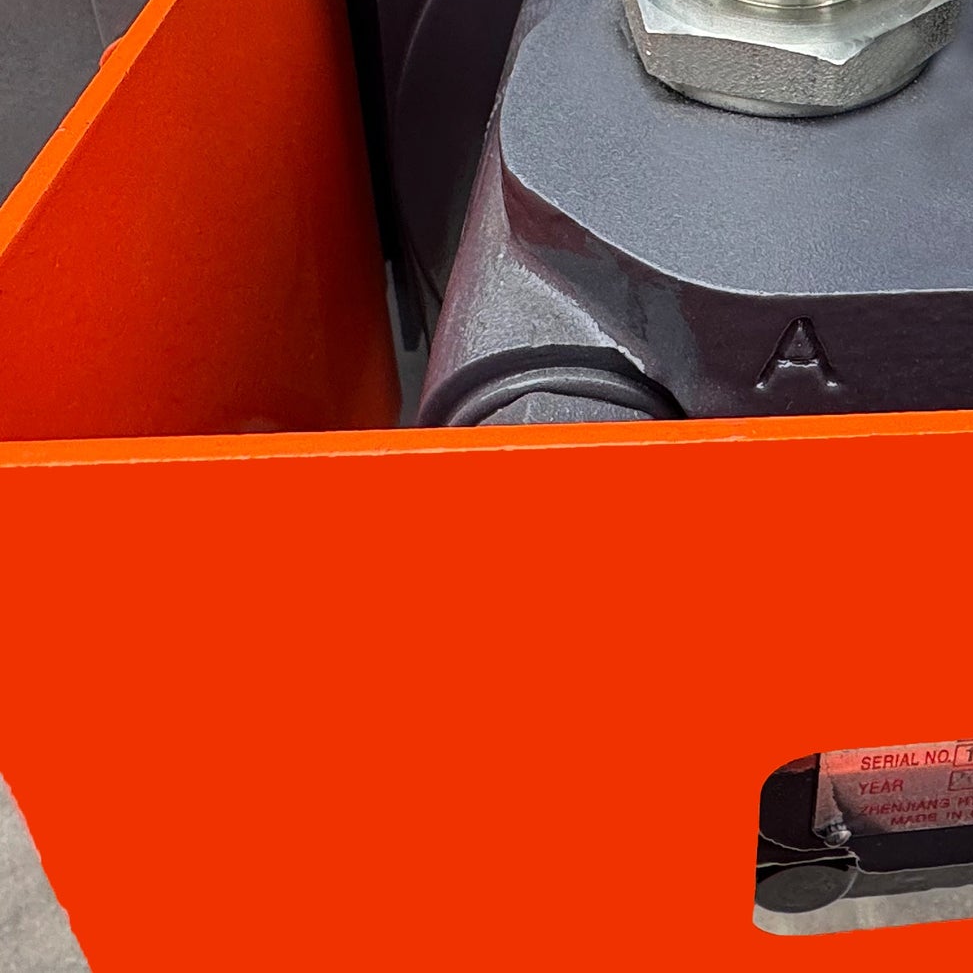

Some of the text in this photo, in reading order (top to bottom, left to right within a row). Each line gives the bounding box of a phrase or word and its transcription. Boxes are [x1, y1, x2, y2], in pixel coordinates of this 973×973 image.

[755, 315, 838, 390] A
[860, 752, 919, 771] SERIAL
[924, 749, 952, 765] NO.
[859, 779, 905, 796] YEAR
[890, 812, 938, 826] MADE
[946, 811, 963, 821] IN
